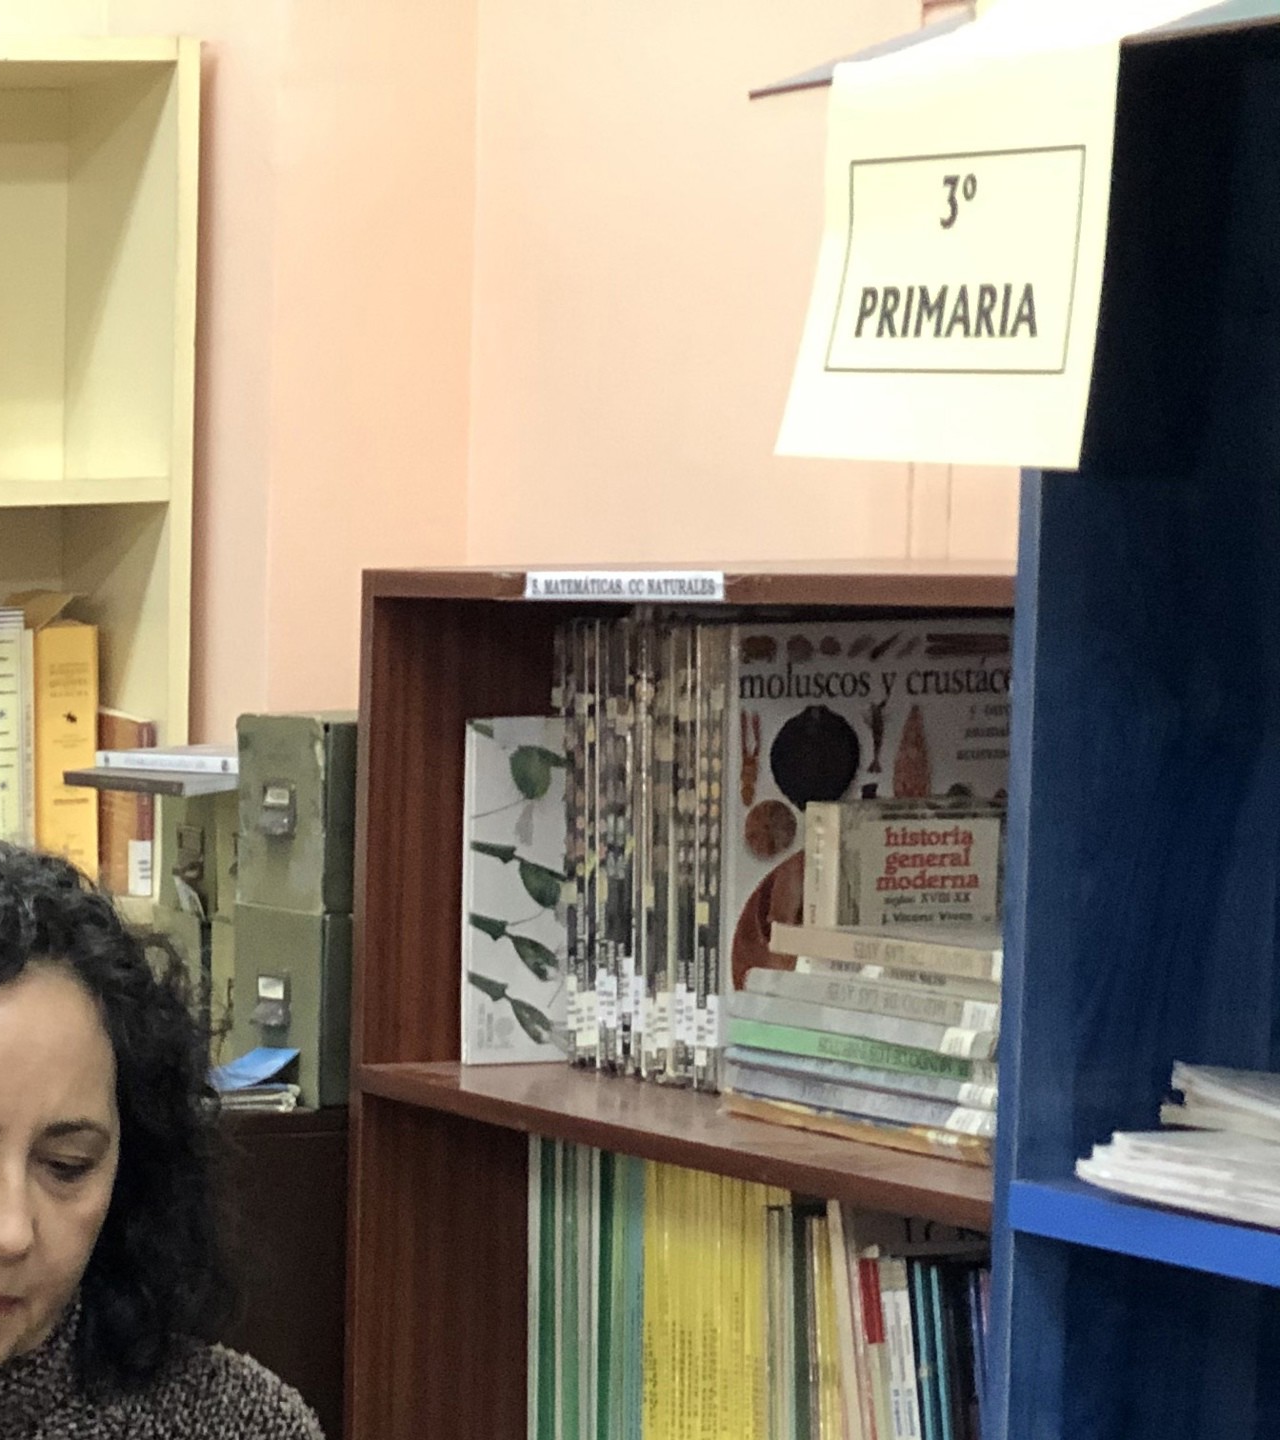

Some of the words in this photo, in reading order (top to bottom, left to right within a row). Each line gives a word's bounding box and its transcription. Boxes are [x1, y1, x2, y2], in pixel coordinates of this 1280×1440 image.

[854, 283, 1038, 338] PRIMARIA
[628, 579, 645, 595] CC
[647, 578, 715, 596] NATURALES
[739, 663, 870, 699] moluscos
[881, 673, 897, 703] y
[885, 826, 974, 848] historia
[885, 848, 971, 875] general
[876, 870, 980, 892] moderna
